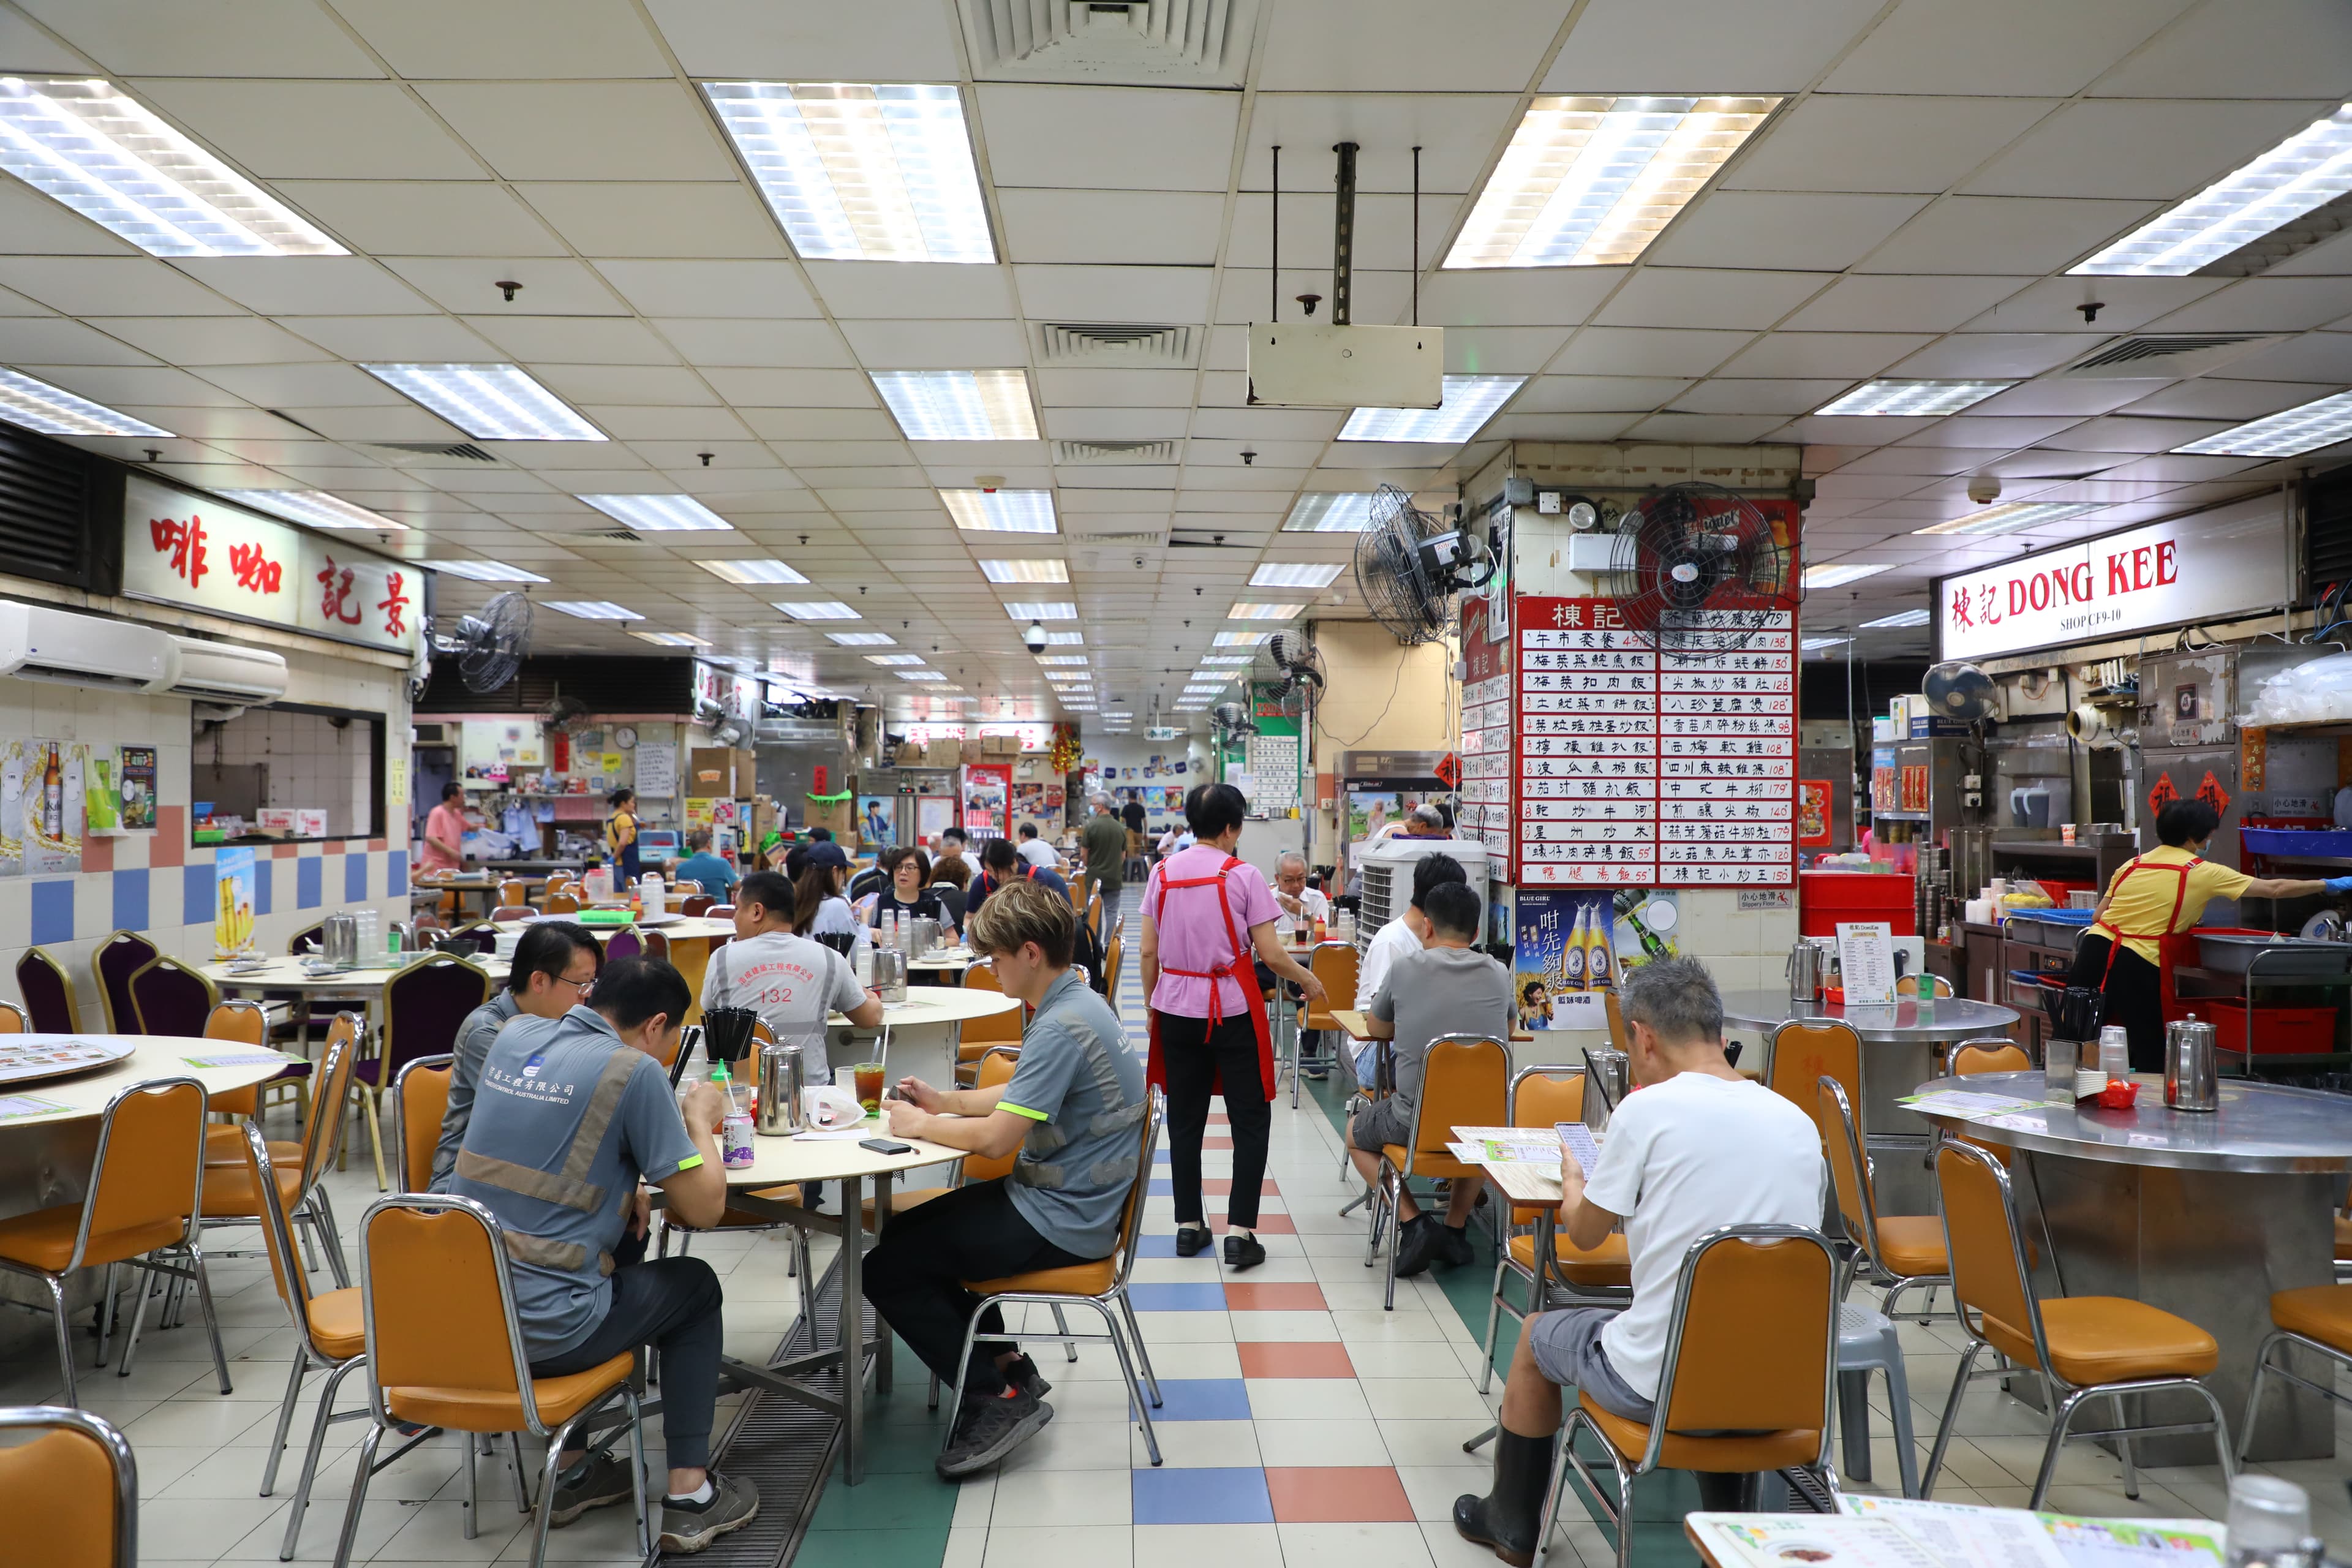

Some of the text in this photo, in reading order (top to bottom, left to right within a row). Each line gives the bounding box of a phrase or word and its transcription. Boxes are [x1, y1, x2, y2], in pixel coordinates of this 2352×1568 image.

[2008, 562, 2094, 617] DONG
[2108, 539, 2179, 596] KEE
[1552, 603, 1626, 629] 棟記
[1768, 613, 1782, 625] 79
[2060, 608, 2122, 631] SHOP CF9-10
[1536, 631, 1615, 649] 午市套餐
[1770, 638, 1785, 647] 138
[1771, 659, 1787, 668] 130
[1773, 680, 1789, 690] 128
[1526, 698, 1531, 709] 3
[1769, 701, 1786, 710] 128
[1526, 720, 1532, 731] 4
[1779, 723, 1790, 733] 98
[1527, 742, 1532, 752] 5
[1766, 745, 1782, 754] 108
[1527, 763, 1532, 774] 6
[1769, 766, 1784, 775] 108
[1526, 780, 1641, 796] 7 茄汁豬扒飯
[1671, 781, 1785, 797] 中式牛柳 179
[2275, 799, 2307, 808] 小心地滑
[1525, 804, 1646, 818] 8 乾炒牛河
[1672, 802, 1787, 818] 煎釀尖椒 140
[1525, 829, 1530, 839] 9
[1773, 828, 1789, 837] 179
[1638, 849, 1649, 858] 55
[1774, 851, 1789, 860] 120
[1542, 866, 1646, 881] 鴨腿湯飯 55
[1673, 867, 1788, 882] 棟記小炒王 150
[1742, 891, 1776, 900] 小心地滑
[1540, 910, 1564, 991] 咁先夠爽
[760, 988, 792, 1003] 132
[514, 1090, 545, 1101] AUSTRALIA
[545, 1096, 569, 1105] LIMITED
